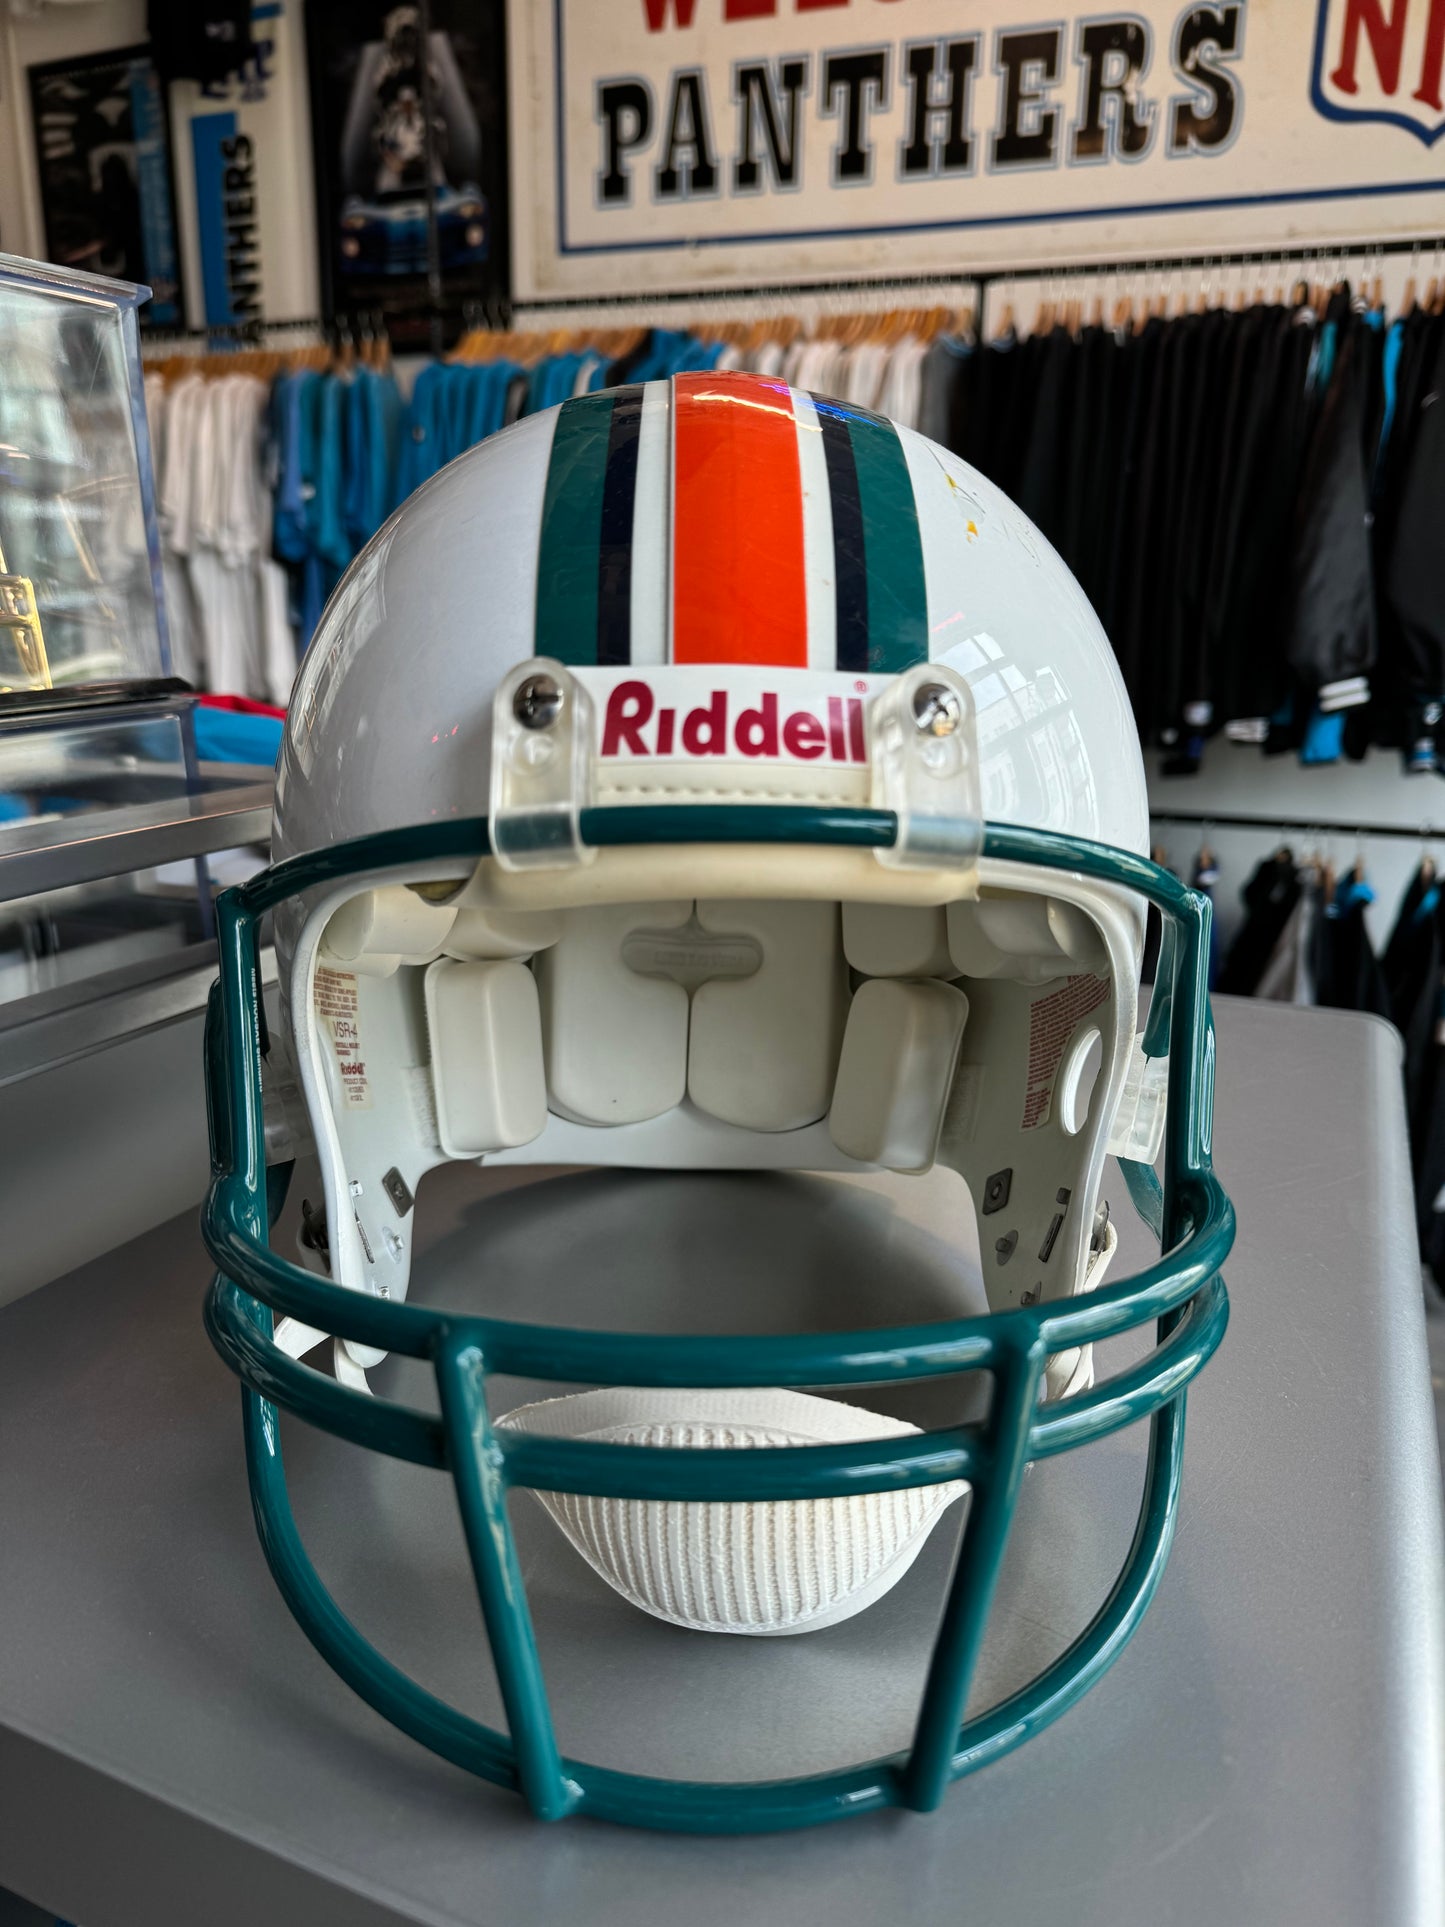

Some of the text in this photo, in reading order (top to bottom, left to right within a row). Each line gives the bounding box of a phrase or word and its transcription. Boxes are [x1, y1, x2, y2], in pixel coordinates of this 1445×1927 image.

[596, 1, 1243, 209] PANTHERS
[221, 135, 264, 346] ANTHERS
[600, 680, 867, 763] Riddell
[333, 1021, 358, 1039] VSR-4
